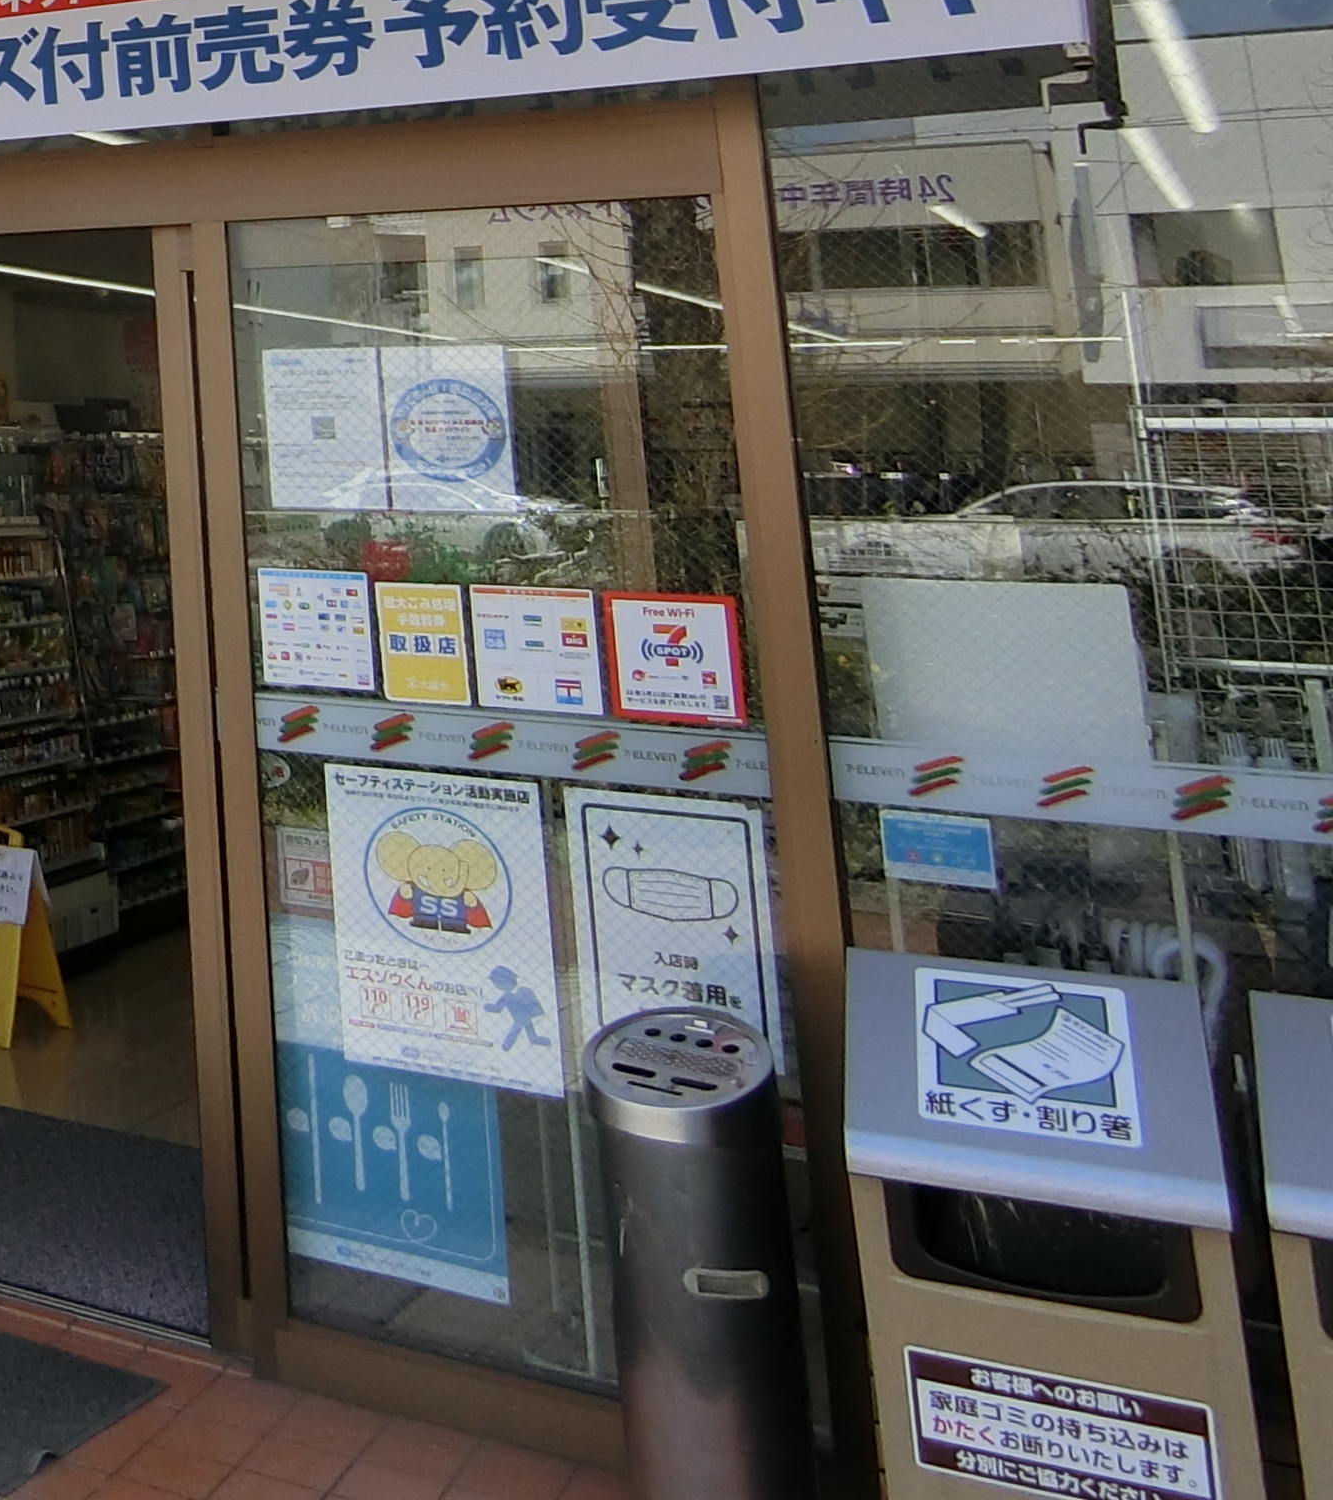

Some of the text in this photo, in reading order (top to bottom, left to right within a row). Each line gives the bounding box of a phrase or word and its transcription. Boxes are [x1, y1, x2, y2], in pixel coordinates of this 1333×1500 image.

[643, 606, 695, 618] Free Wi-Fi
[334, 772, 531, 804] セーフティステーション活動実施店
[390, 812, 476, 838] SAFETY STATION
[653, 951, 699, 970] 入店時
[362, 988, 430, 1011] 110 119
[617, 972, 743, 1010] マスク着用を
[925, 1090, 1133, 1141] 紙くず・割り箸
[970, 1367, 1144, 1418] お客様へのお願い
[929, 1389, 1189, 1461] 家庭ゴミの持ち込みは
[932, 1414, 1197, 1488] かたくお断りいたします。
